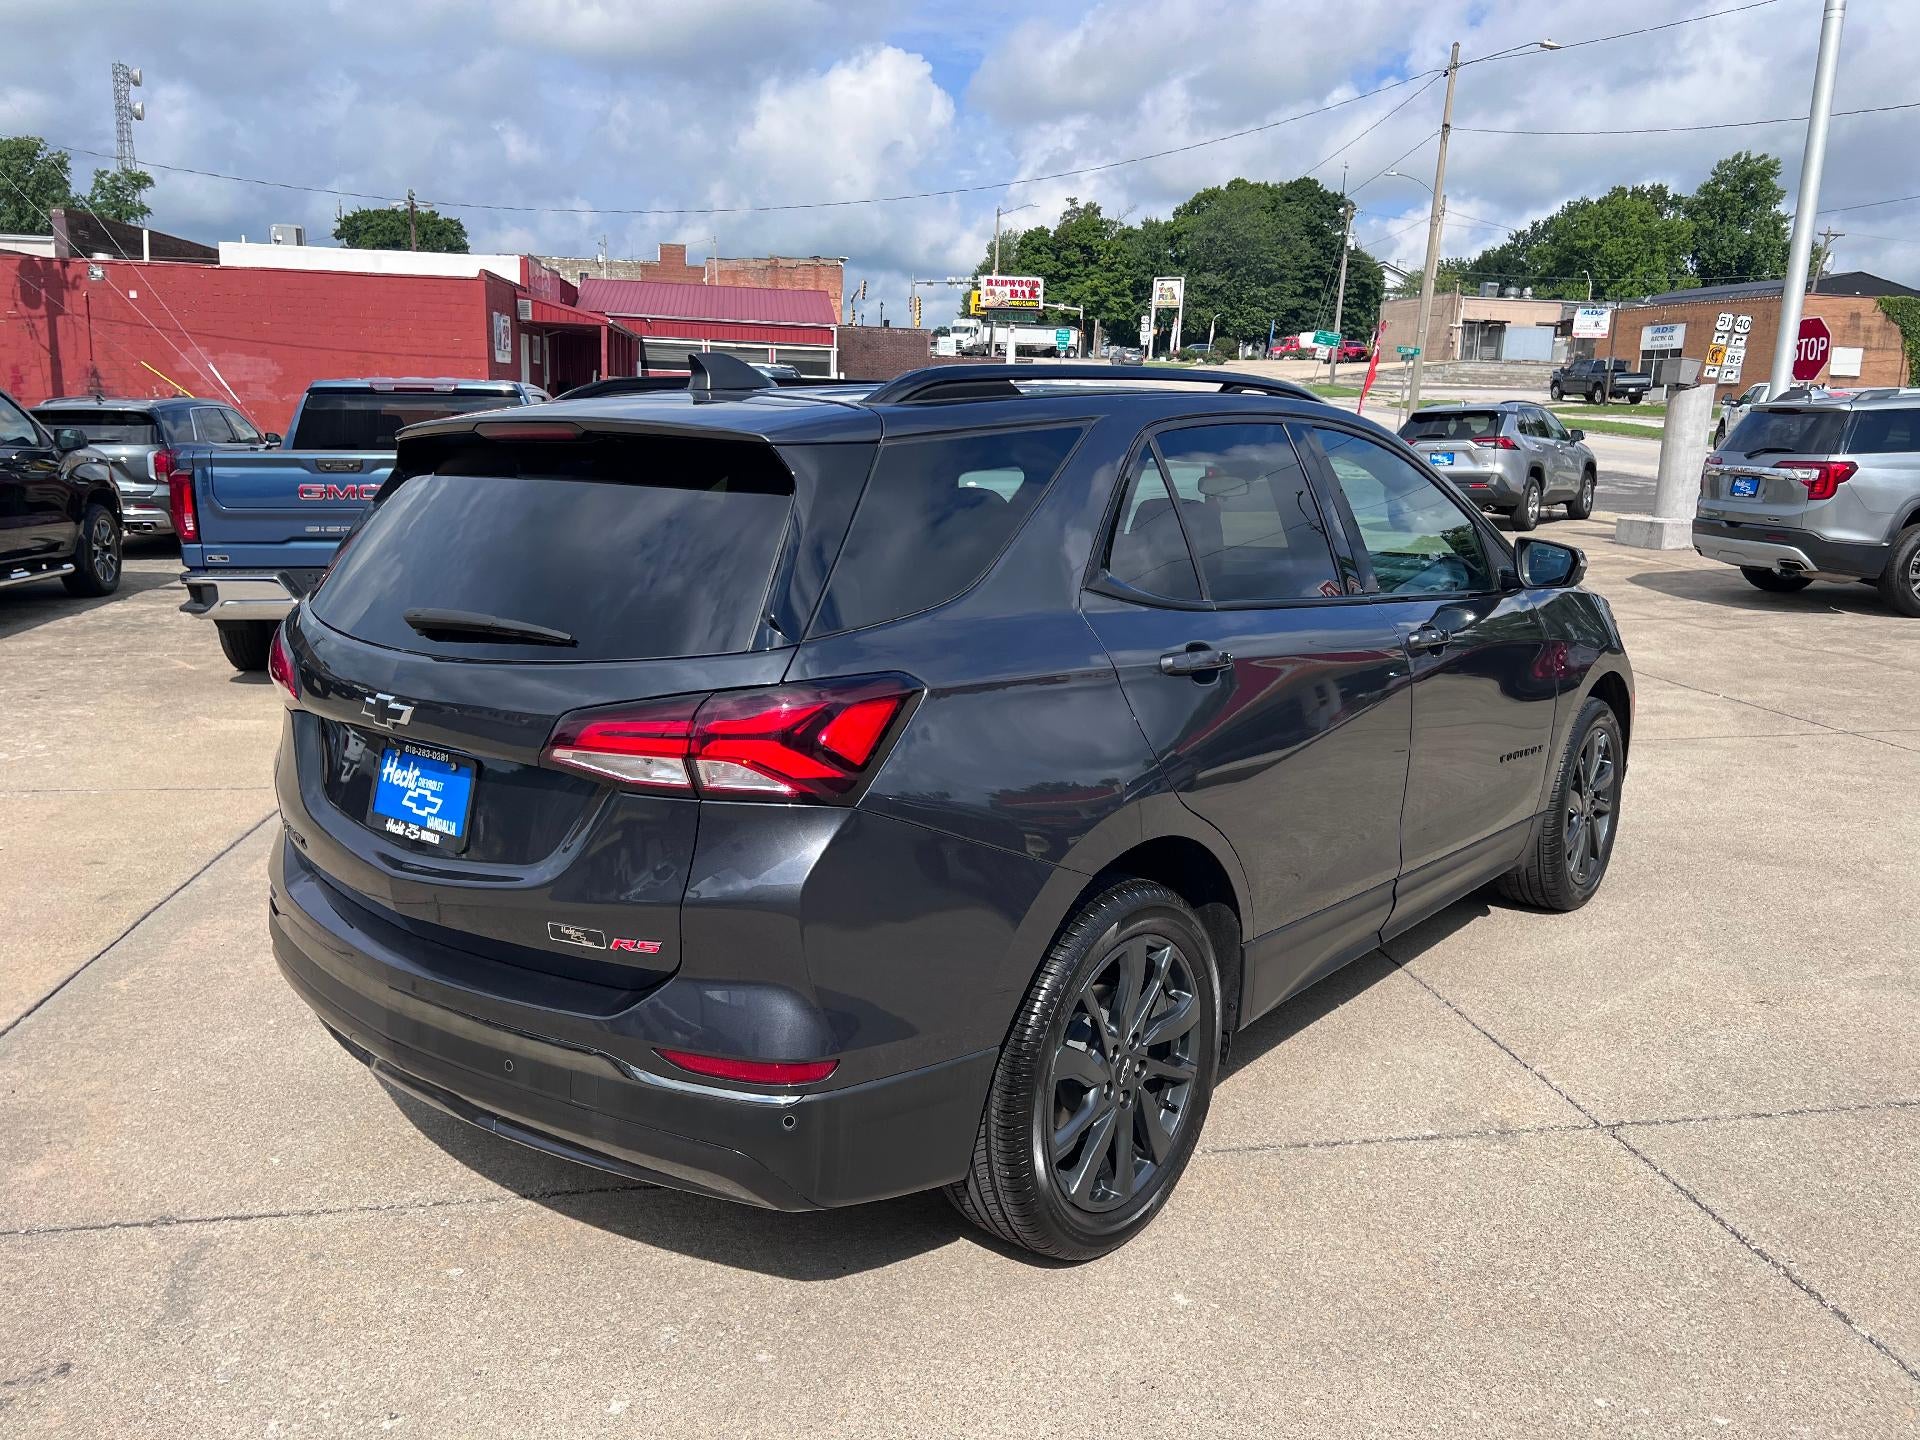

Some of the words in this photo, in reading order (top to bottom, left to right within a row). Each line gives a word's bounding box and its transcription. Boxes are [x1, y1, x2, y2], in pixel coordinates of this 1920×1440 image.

[1009, 289, 1039, 299] BAR
[1719, 316, 1731, 327] 51
[1736, 319, 1750, 330] 40
[1654, 326, 1676, 334] ADS
[1726, 354, 1742, 364] 185
[298, 484, 381, 500] GMC
[382, 755, 420, 790] Hecht
[417, 777, 445, 792] CHEVROLET
[385, 818, 406, 835] Hecht
[426, 815, 457, 836] VANDALIA
[610, 938, 663, 954] RS
